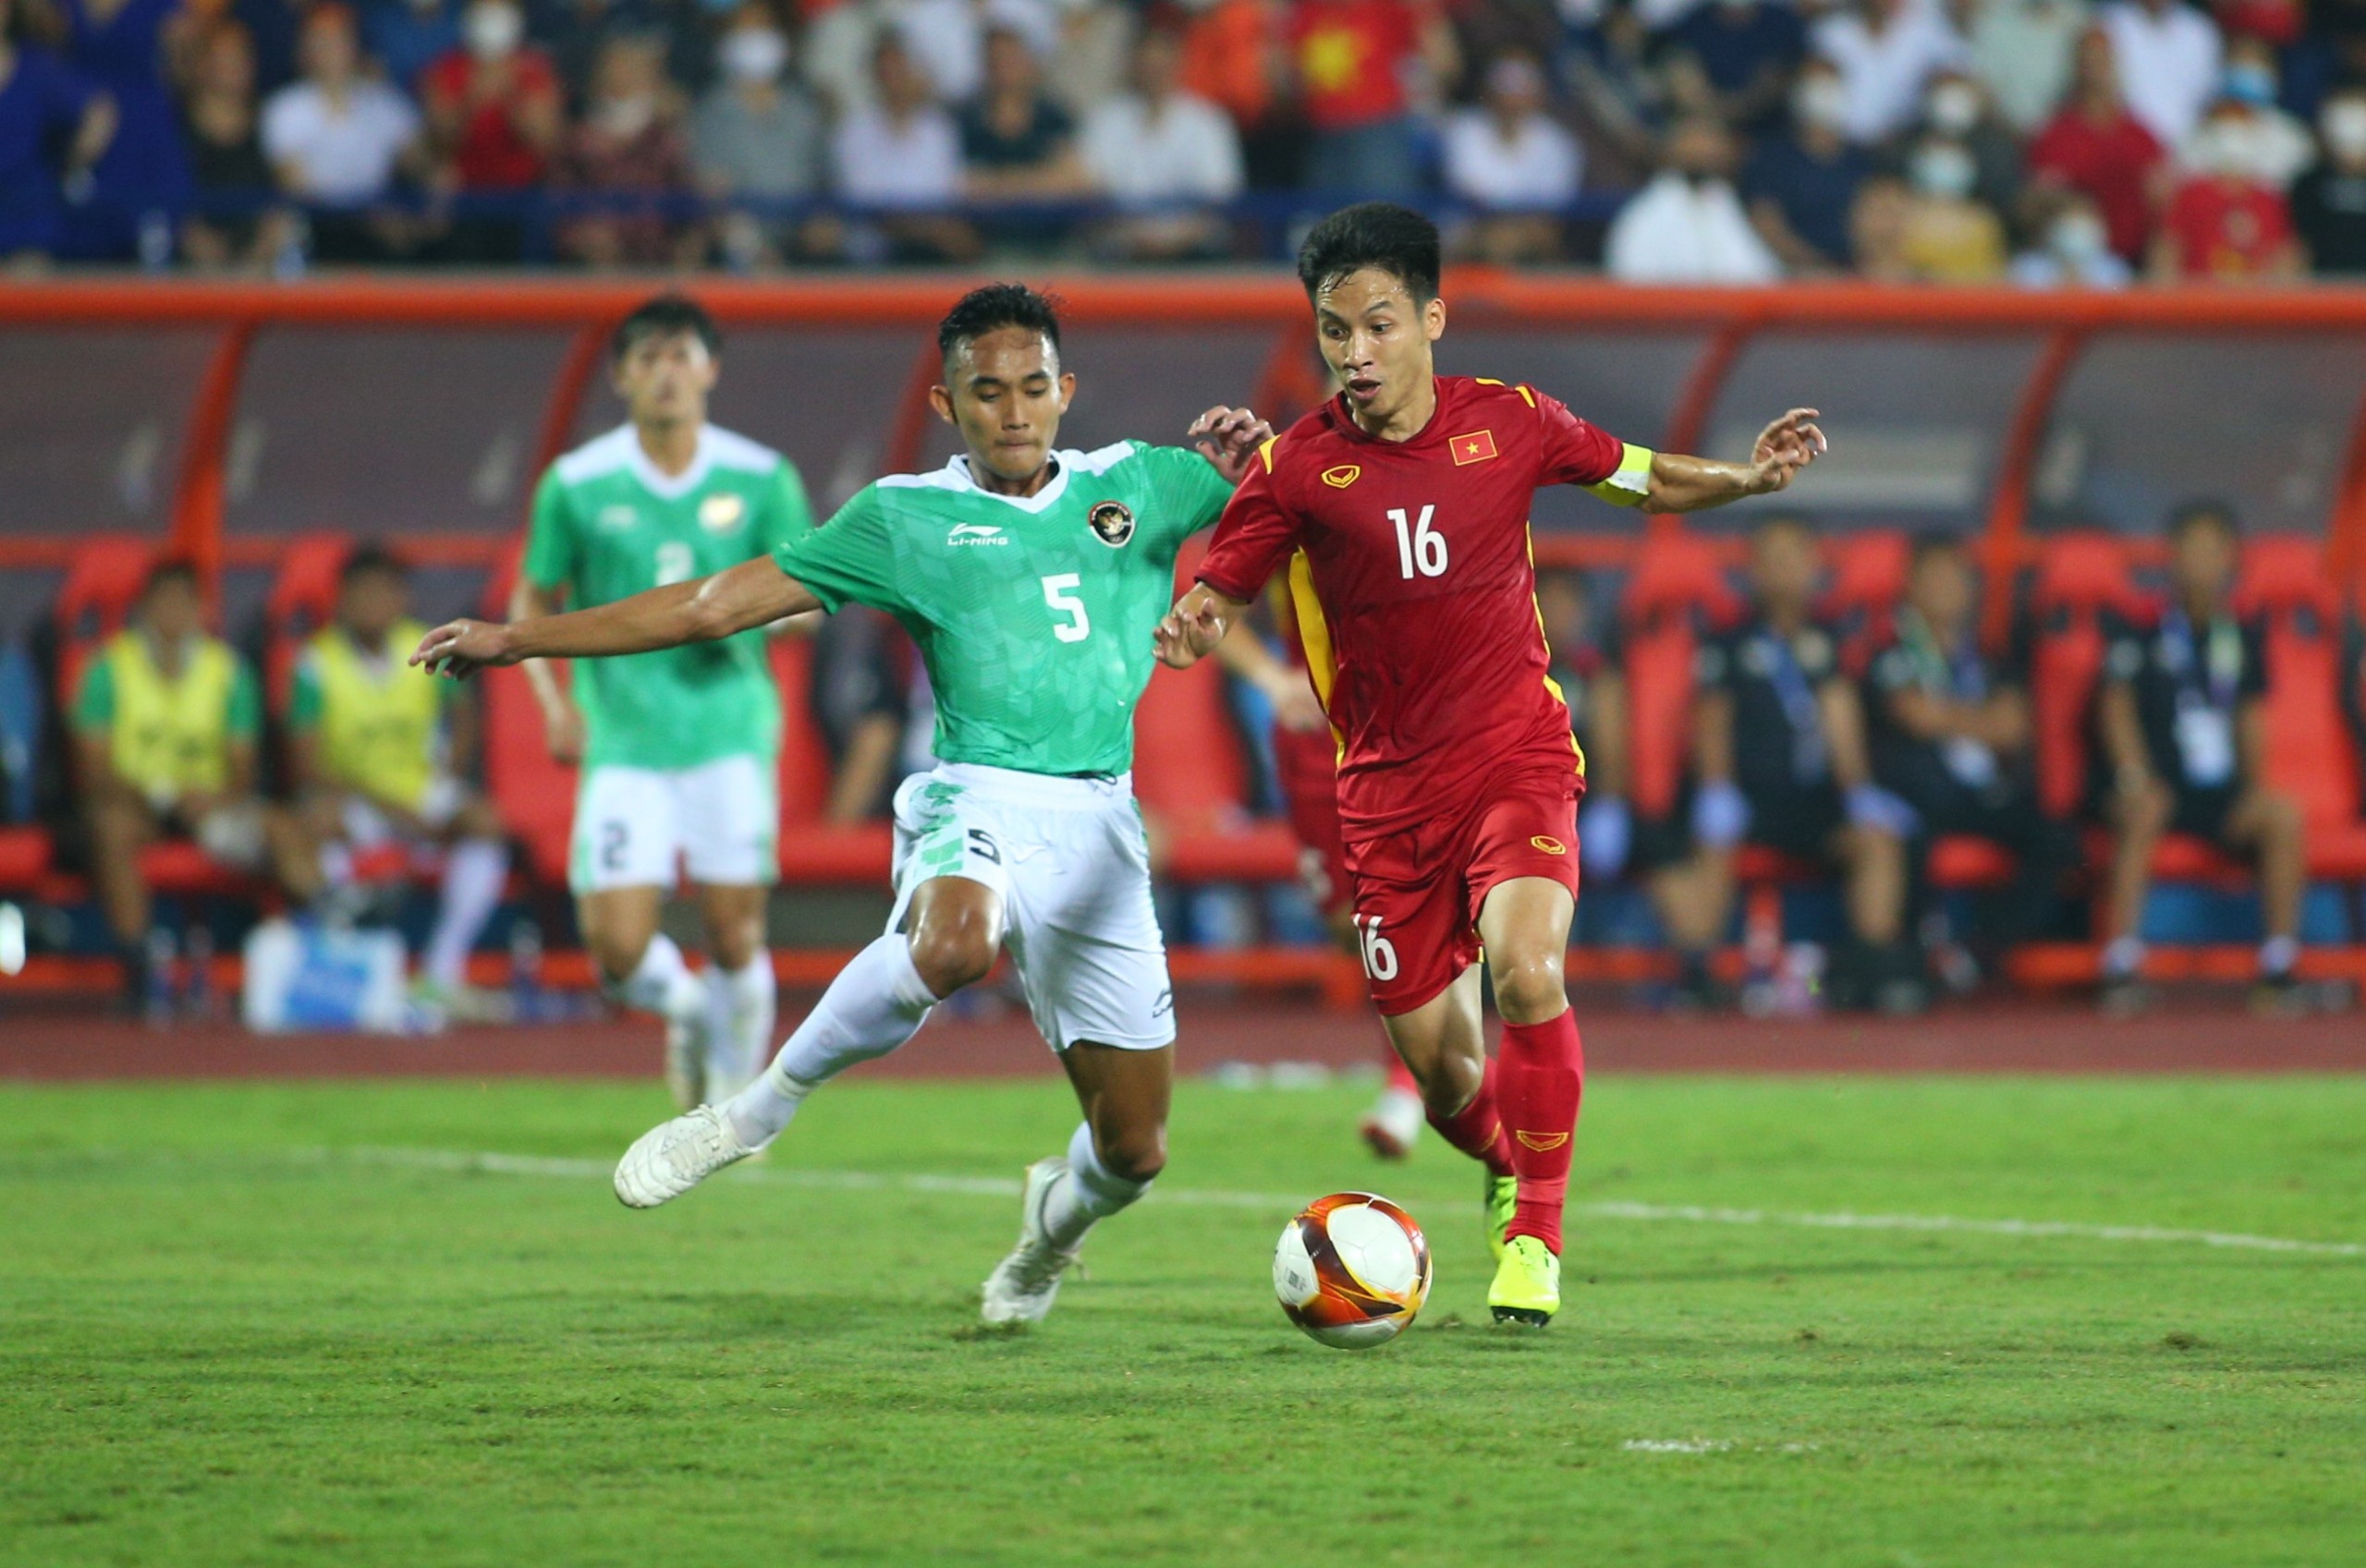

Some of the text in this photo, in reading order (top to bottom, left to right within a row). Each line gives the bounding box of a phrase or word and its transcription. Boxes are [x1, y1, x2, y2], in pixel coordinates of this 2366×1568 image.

[946, 536, 1009, 547] LI-NING
[1387, 504, 1448, 579] 16
[1041, 573, 1090, 643] 5
[603, 820, 630, 870] 2
[968, 828, 1001, 866] 5
[1353, 913, 1398, 980] 16
